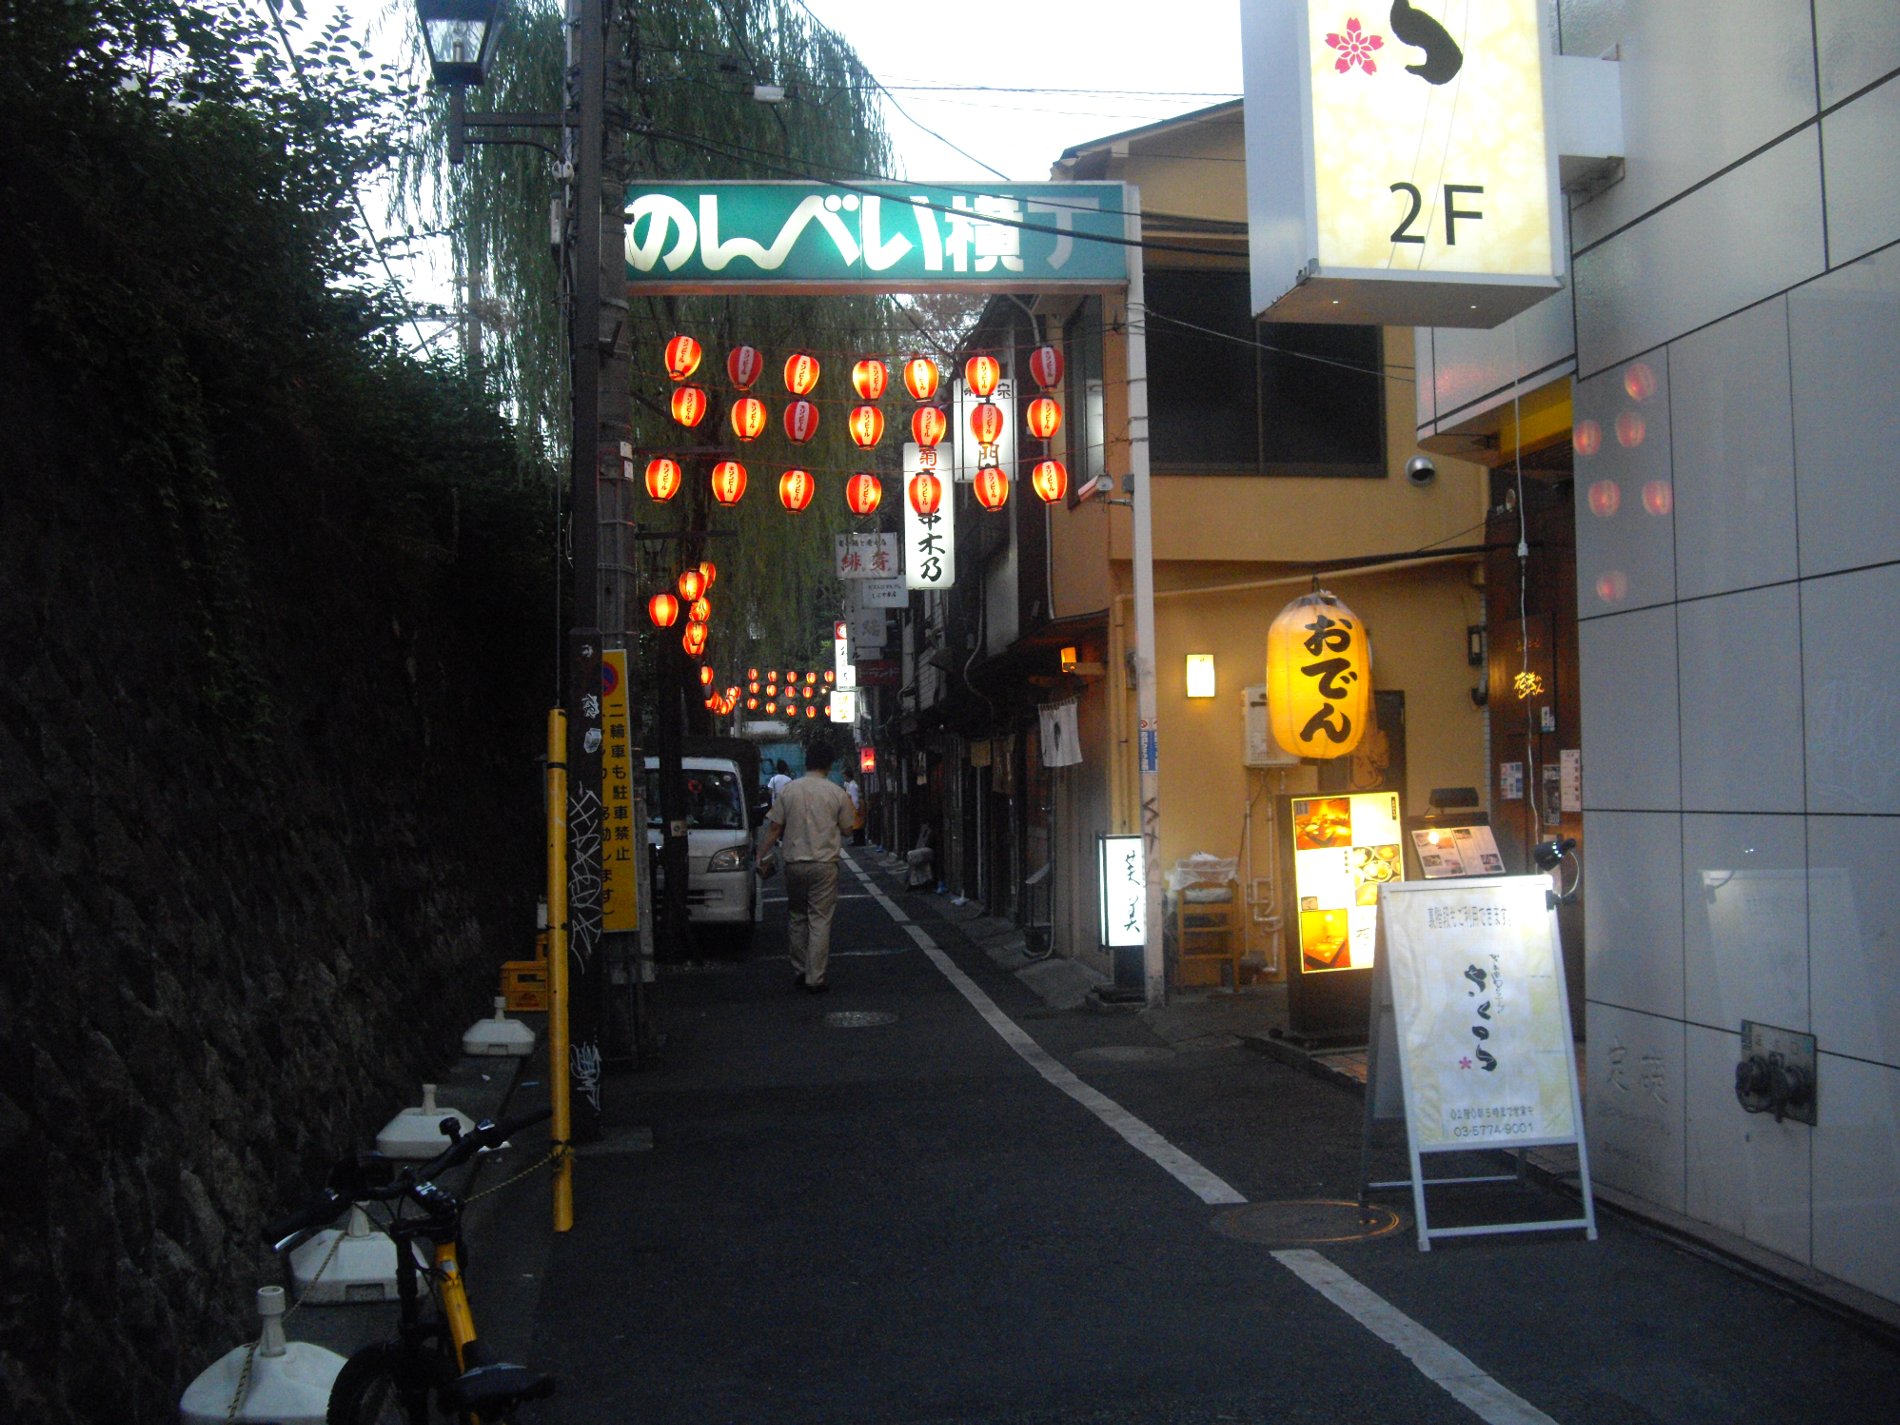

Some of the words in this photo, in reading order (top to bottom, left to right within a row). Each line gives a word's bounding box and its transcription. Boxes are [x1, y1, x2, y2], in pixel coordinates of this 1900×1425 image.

[626, 193, 1099, 272] のんべい横丁
[1390, 182, 1484, 245] 2F
[1299, 614, 1358, 746] おでん
[608, 703, 630, 862] 二輪車も駐車禁止
